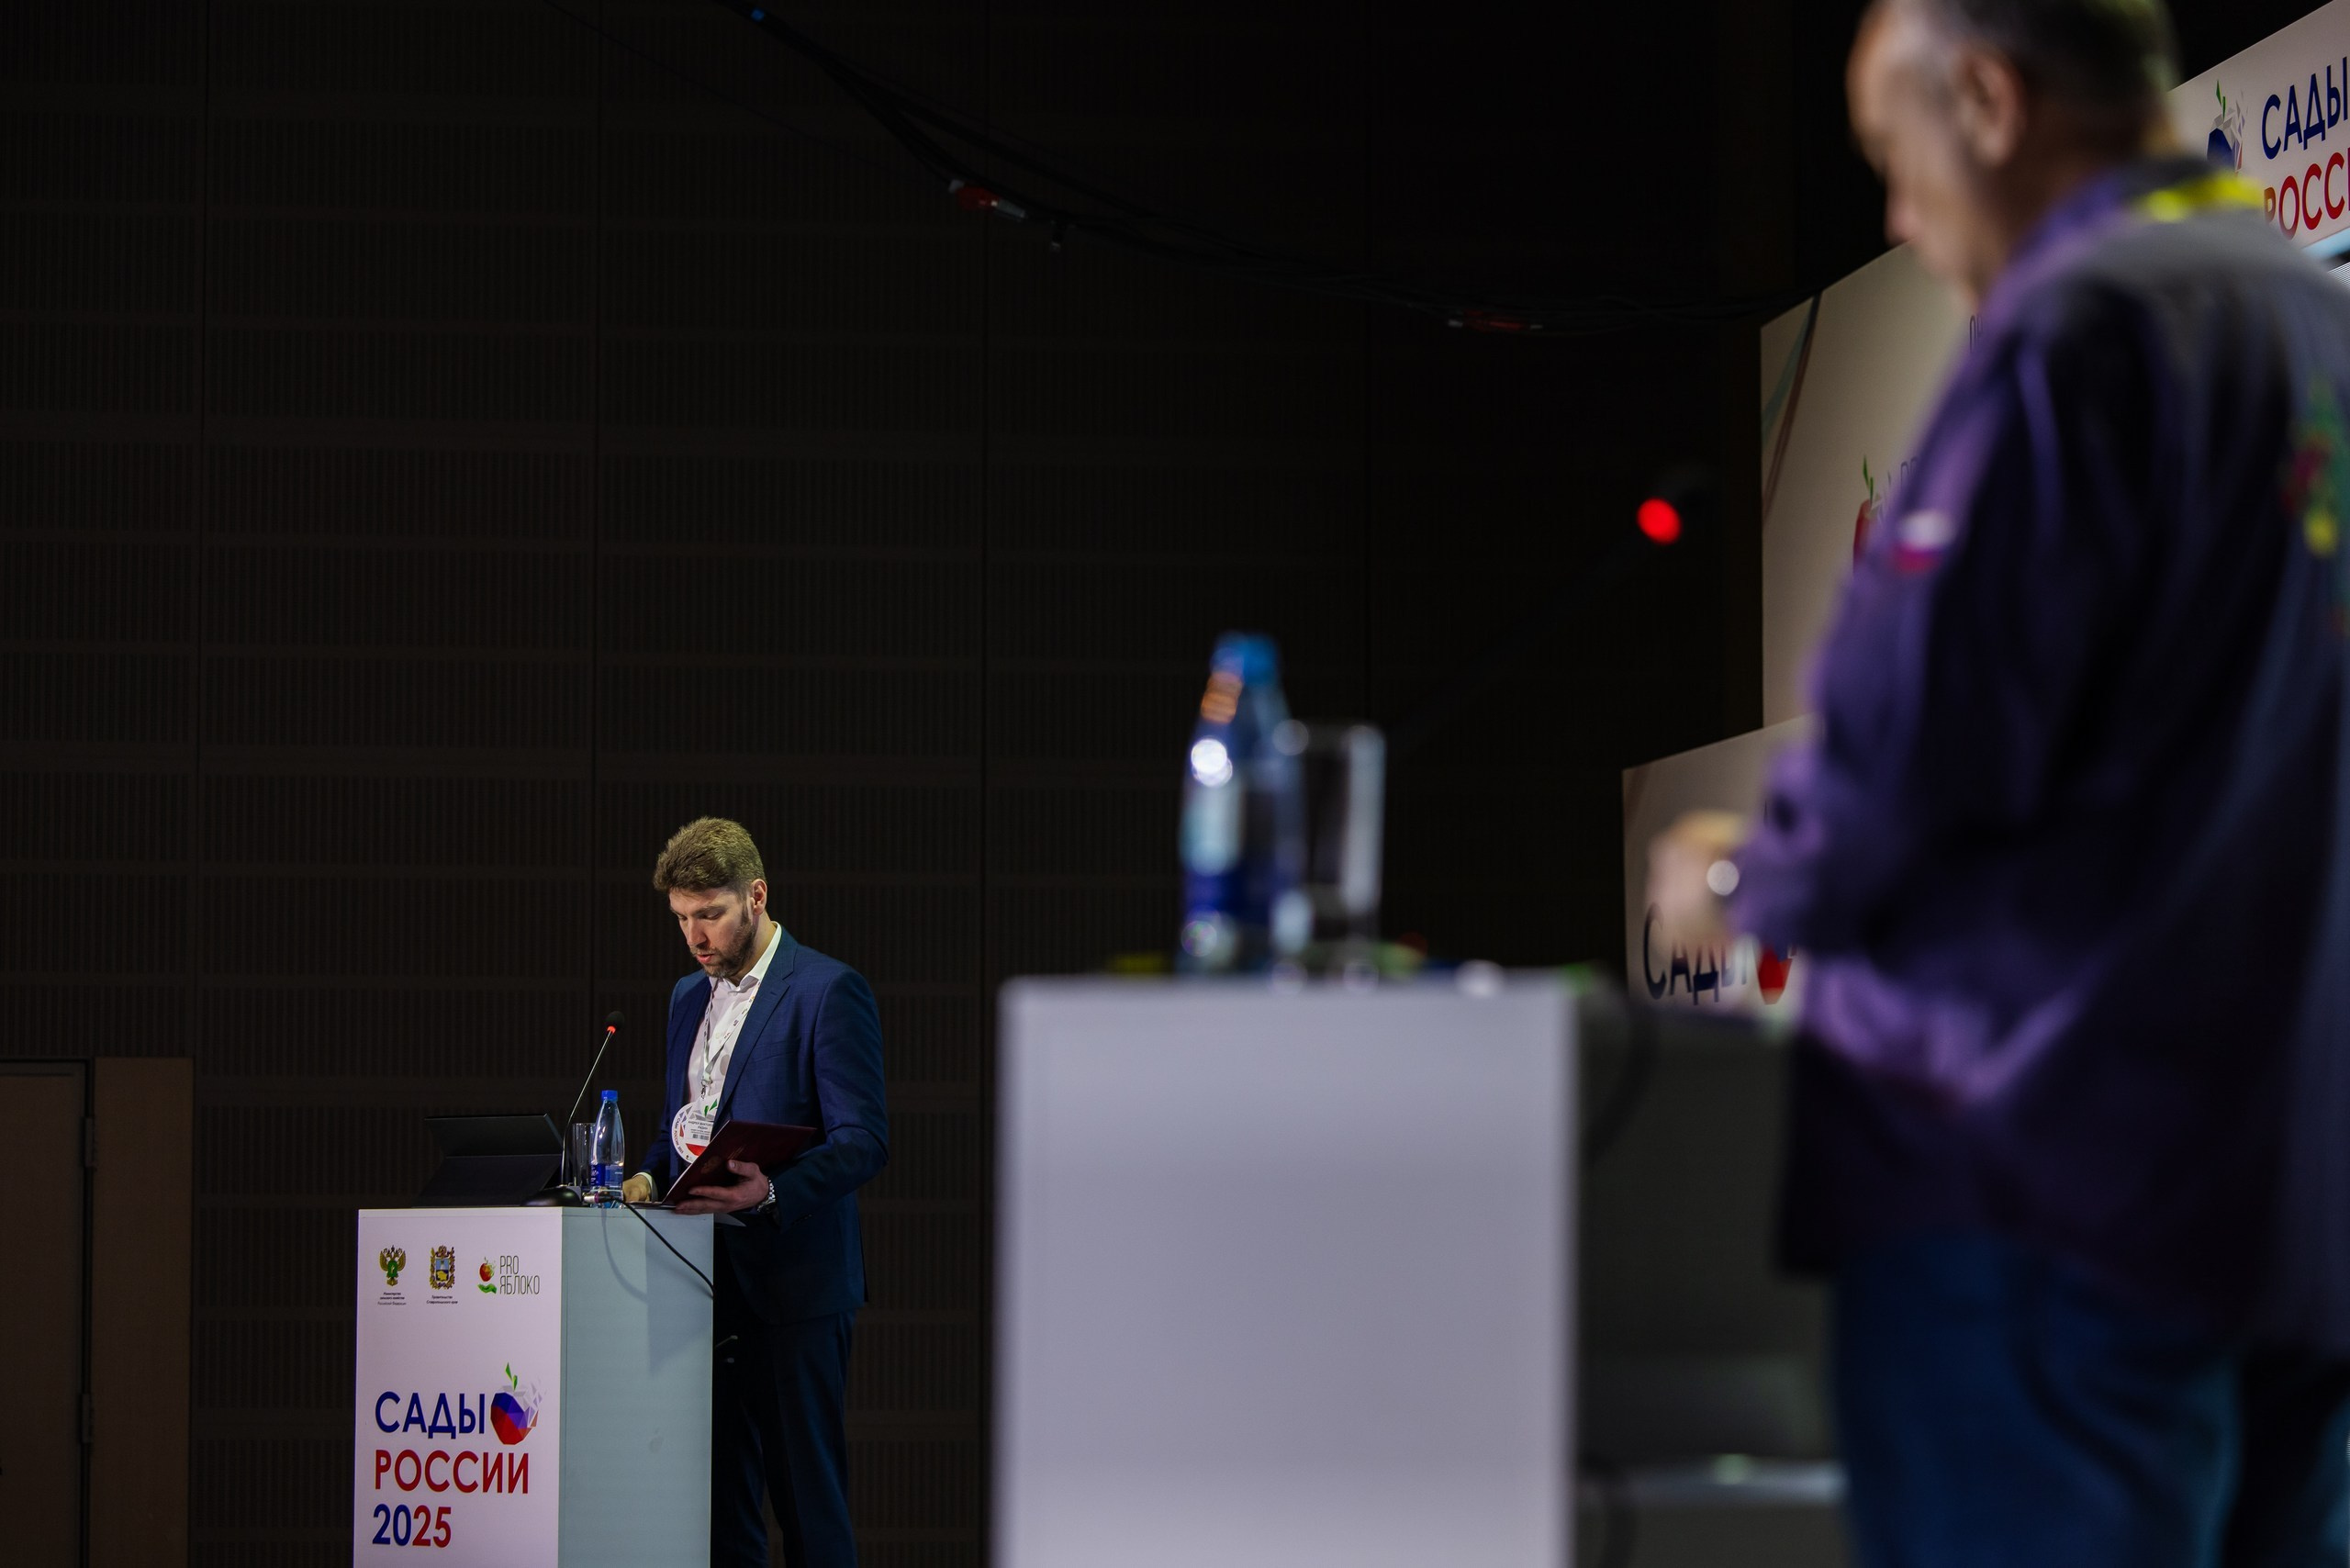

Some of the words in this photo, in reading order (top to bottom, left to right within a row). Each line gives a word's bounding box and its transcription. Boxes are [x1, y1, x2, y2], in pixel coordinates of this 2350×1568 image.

[2261, 56, 2348, 160] САДЫ
[2264, 147, 2350, 241] РОСС
[499, 1255, 520, 1275] PRO
[499, 1275, 541, 1295] ЯБЛОКО
[375, 1391, 486, 1439] САДЫ
[375, 1449, 530, 1495] РОССИИ
[372, 1503, 453, 1548] 2025
